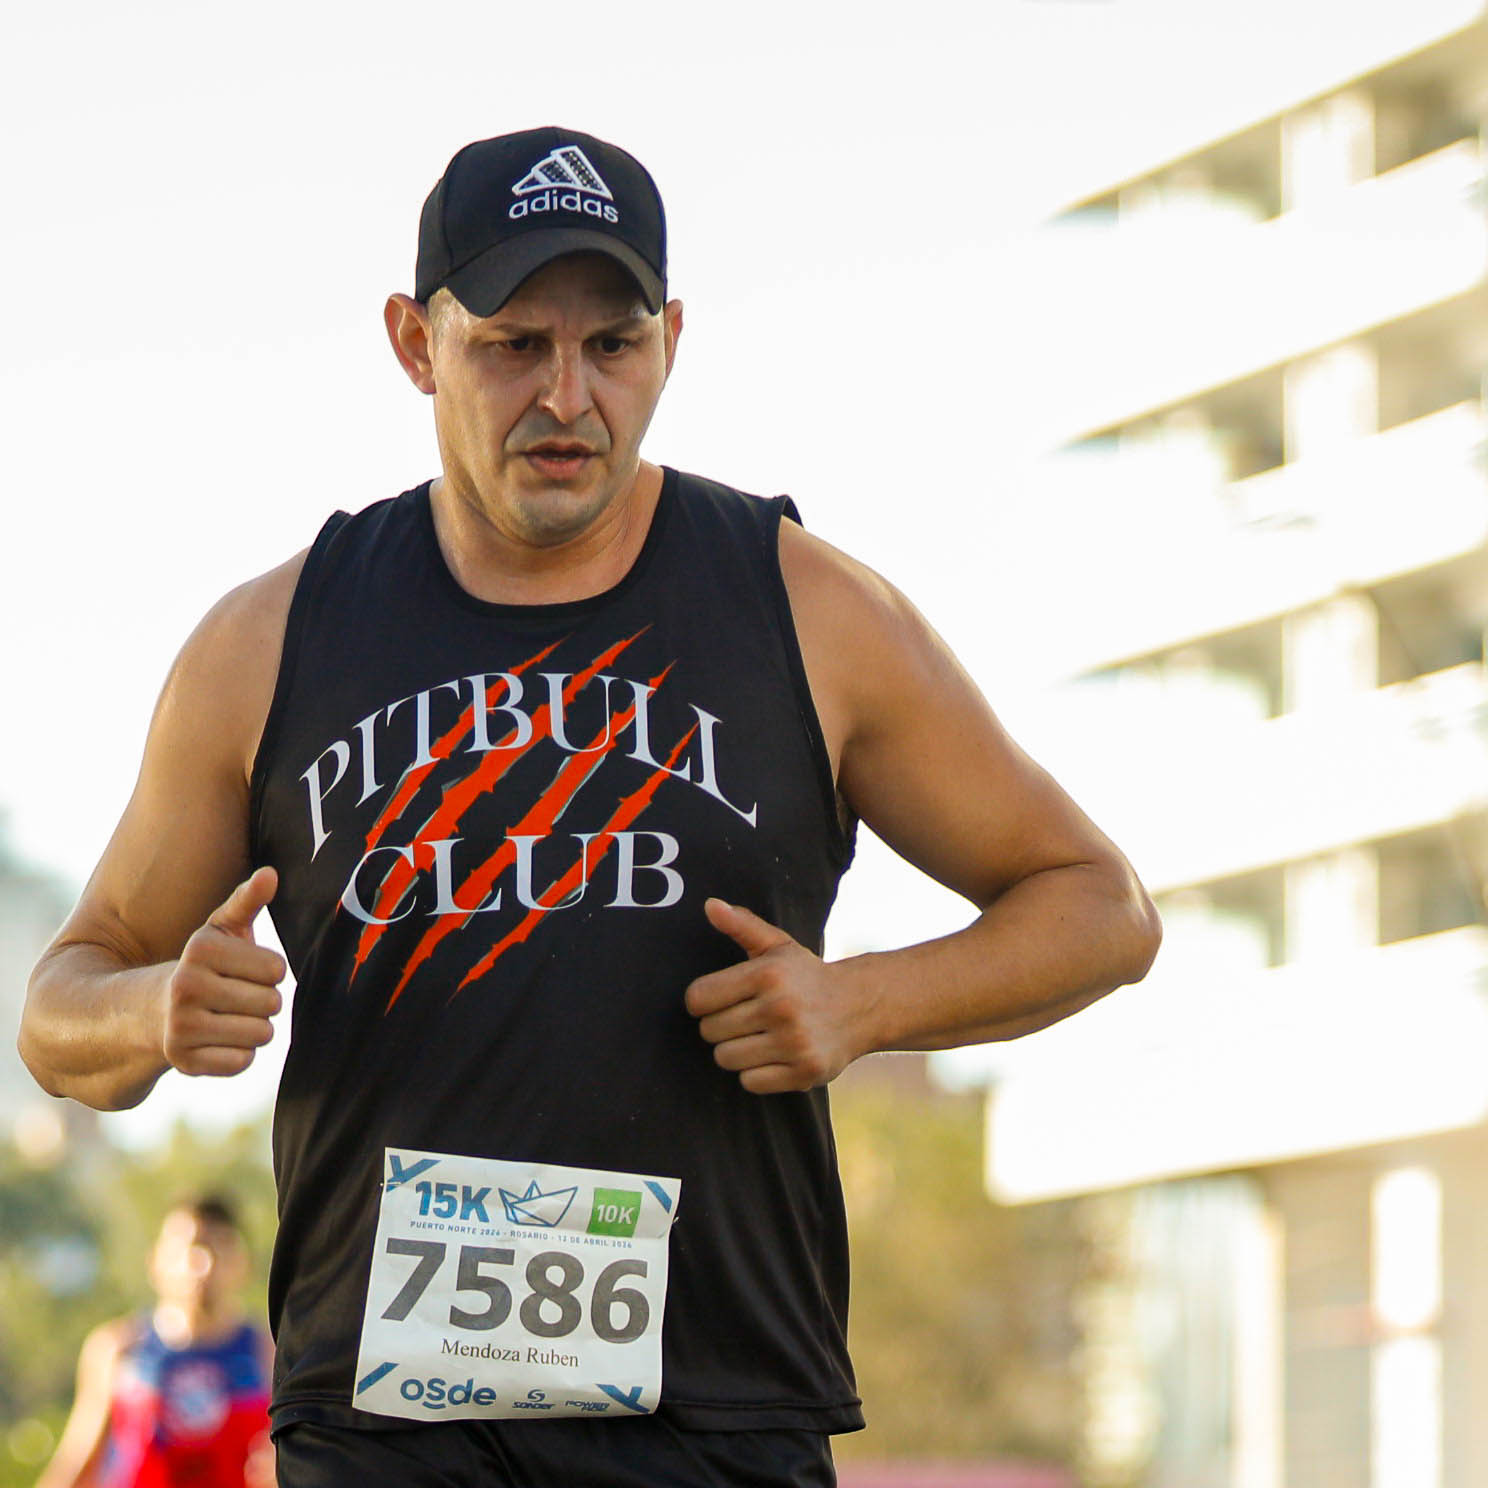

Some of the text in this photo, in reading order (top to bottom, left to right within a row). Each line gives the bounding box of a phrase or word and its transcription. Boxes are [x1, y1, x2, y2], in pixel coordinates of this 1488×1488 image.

[508, 189, 619, 223] adidas
[298, 671, 757, 864] PITBULL
[341, 831, 686, 925] CLUB
[414, 1180, 492, 1223] 15K
[596, 1203, 635, 1225] 10K
[410, 1220, 445, 1231] PUERTO
[447, 1224, 476, 1235] NORTE
[510, 1229, 549, 1240] ROSARIO
[571, 1235, 580, 1244] DE
[584, 1237, 609, 1247] ABRIL
[380, 1237, 650, 1344] 7586
[441, 1338, 579, 1368] Mendoza Ruben
[400, 1377, 497, 1408] osde
